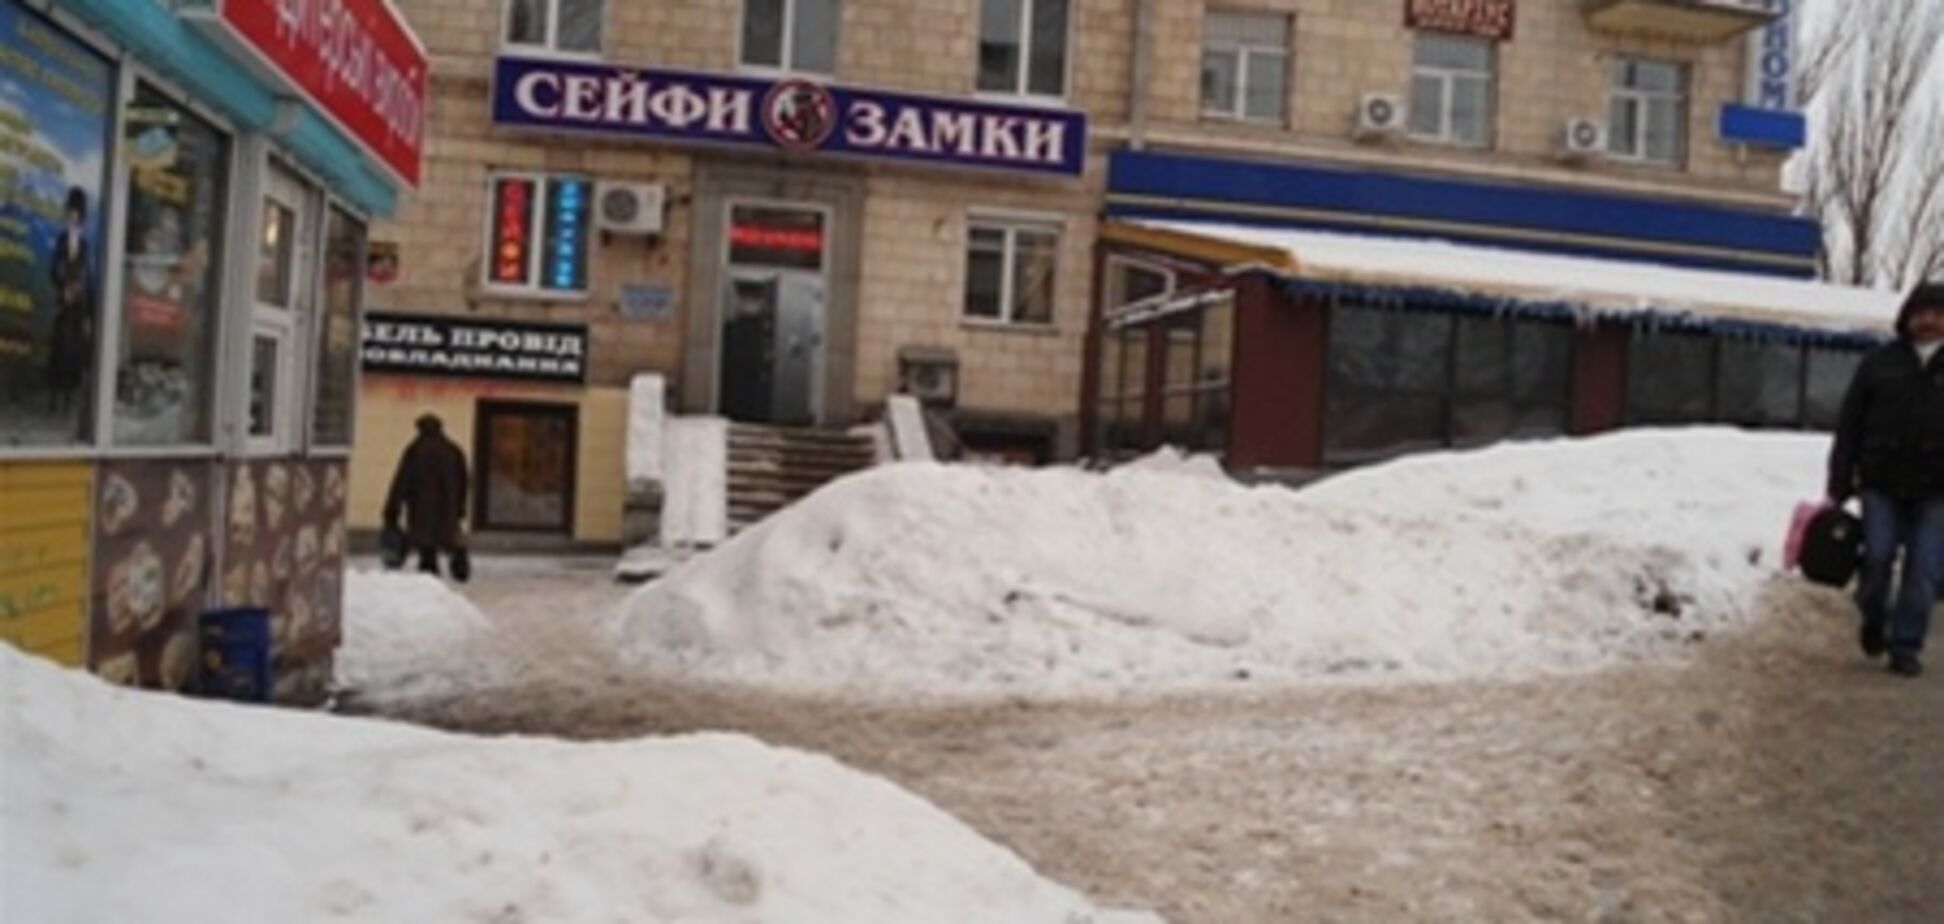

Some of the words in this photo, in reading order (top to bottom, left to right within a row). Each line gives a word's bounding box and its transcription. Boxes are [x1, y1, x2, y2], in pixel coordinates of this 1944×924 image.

[514, 72, 752, 134] СЕЙФИ
[845, 101, 1065, 162] ЗАМКИ
[450, 328, 583, 356] ПРОВІД
